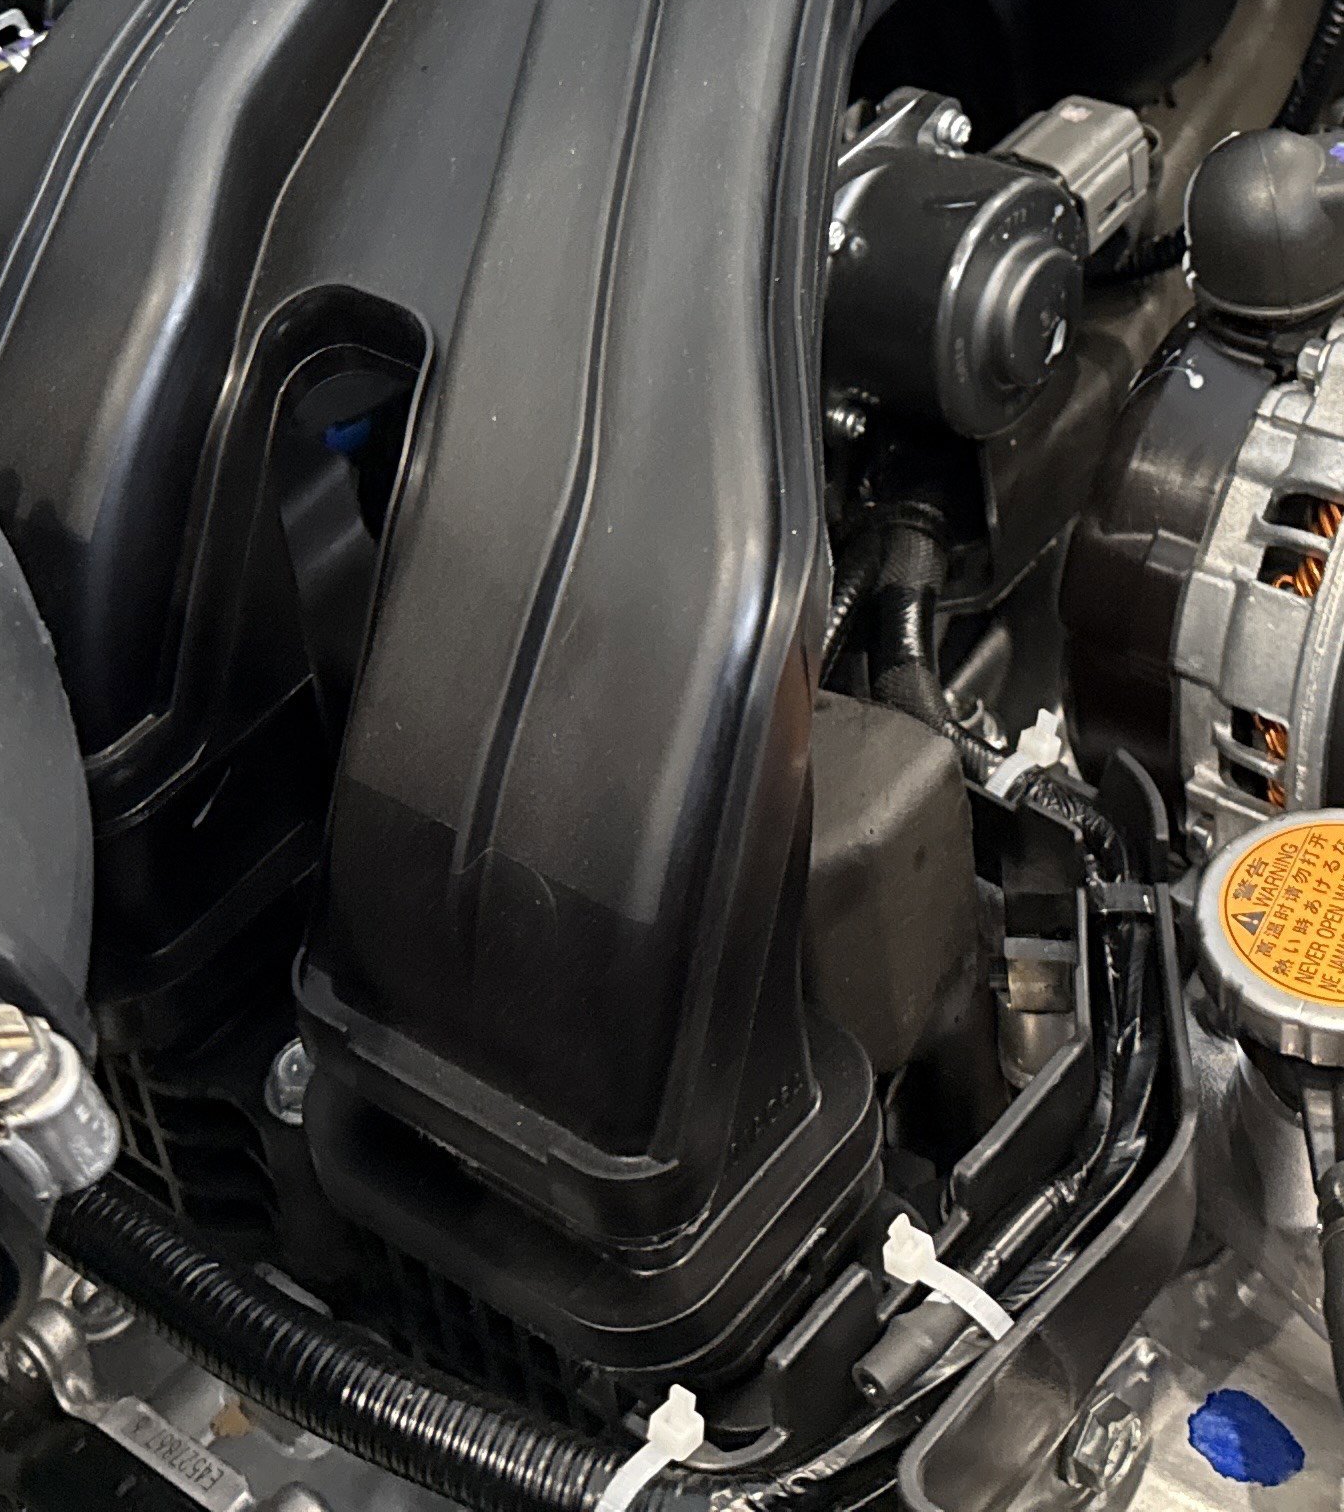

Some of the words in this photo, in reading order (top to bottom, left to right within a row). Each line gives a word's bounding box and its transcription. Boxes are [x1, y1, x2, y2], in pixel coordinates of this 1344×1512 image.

[1232, 857, 1270, 902] 警告
[1252, 843, 1299, 908] WARNING
[1294, 941, 1330, 985] NEVER
[1318, 973, 1341, 993] NE
